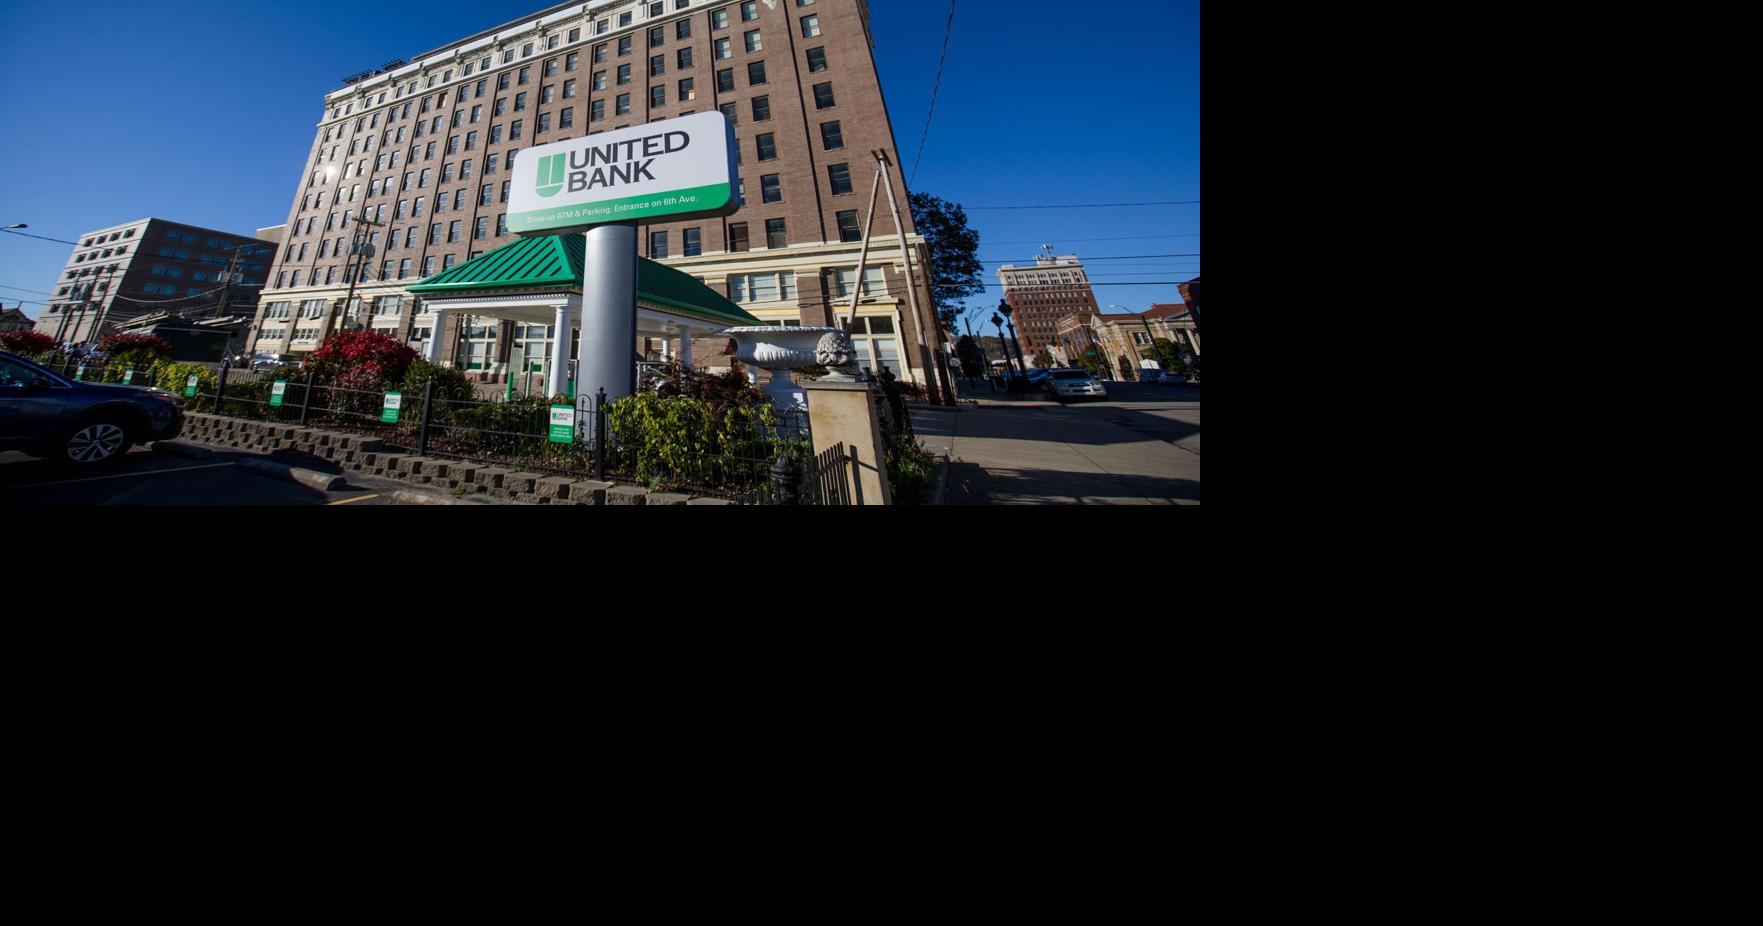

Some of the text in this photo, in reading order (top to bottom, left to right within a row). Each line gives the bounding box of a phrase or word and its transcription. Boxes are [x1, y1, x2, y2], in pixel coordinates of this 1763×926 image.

[569, 130, 690, 170] UNITED
[567, 158, 656, 193] BANK
[556, 211, 573, 219] ATM
[582, 207, 612, 216] Parking:
[614, 202, 649, 212] Entrance
[663, 197, 677, 205] 6th
[678, 195, 698, 203] Ave.
